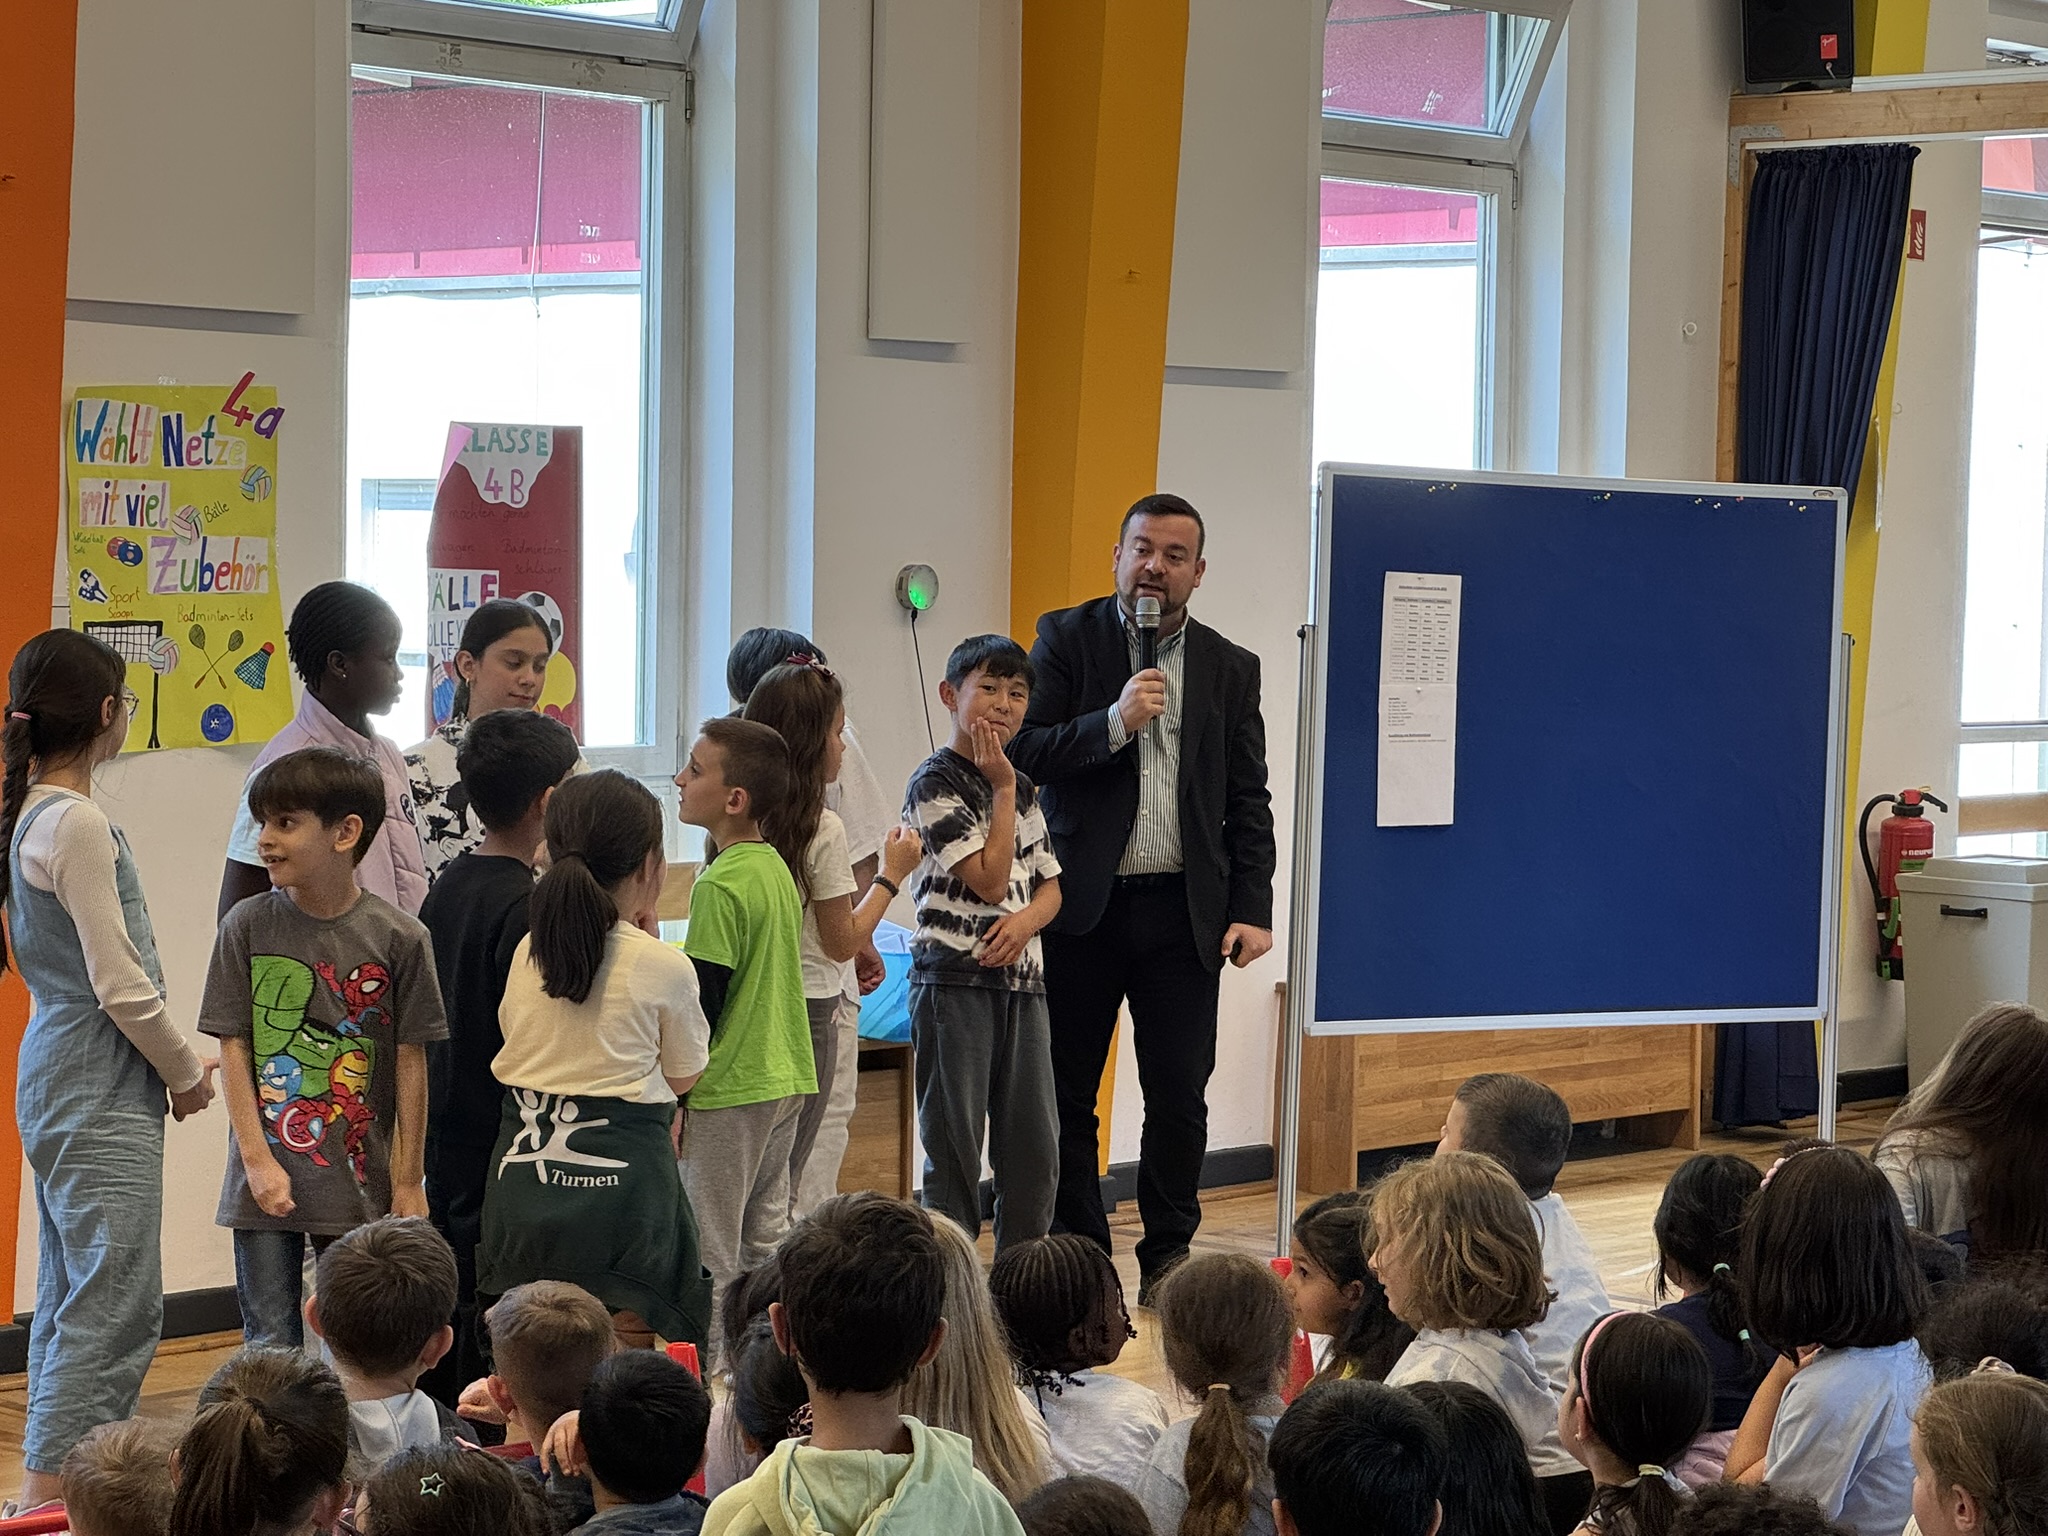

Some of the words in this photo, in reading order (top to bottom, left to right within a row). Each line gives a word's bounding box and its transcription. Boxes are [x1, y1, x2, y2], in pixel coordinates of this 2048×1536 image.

[221, 371, 285, 439] 4a
[76, 400, 152, 464] Wählt
[162, 413, 247, 467] Netze
[462, 427, 549, 456] LASSE
[81, 480, 119, 527] mit
[126, 484, 169, 529] viel
[203, 501, 230, 523] Bälle
[150, 536, 268, 594] Zubehör
[109, 584, 140, 608] Sport
[432, 572, 498, 611] ÄLLE
[108, 606, 134, 619] Scoops
[551, 1169, 619, 1188] Turnen
